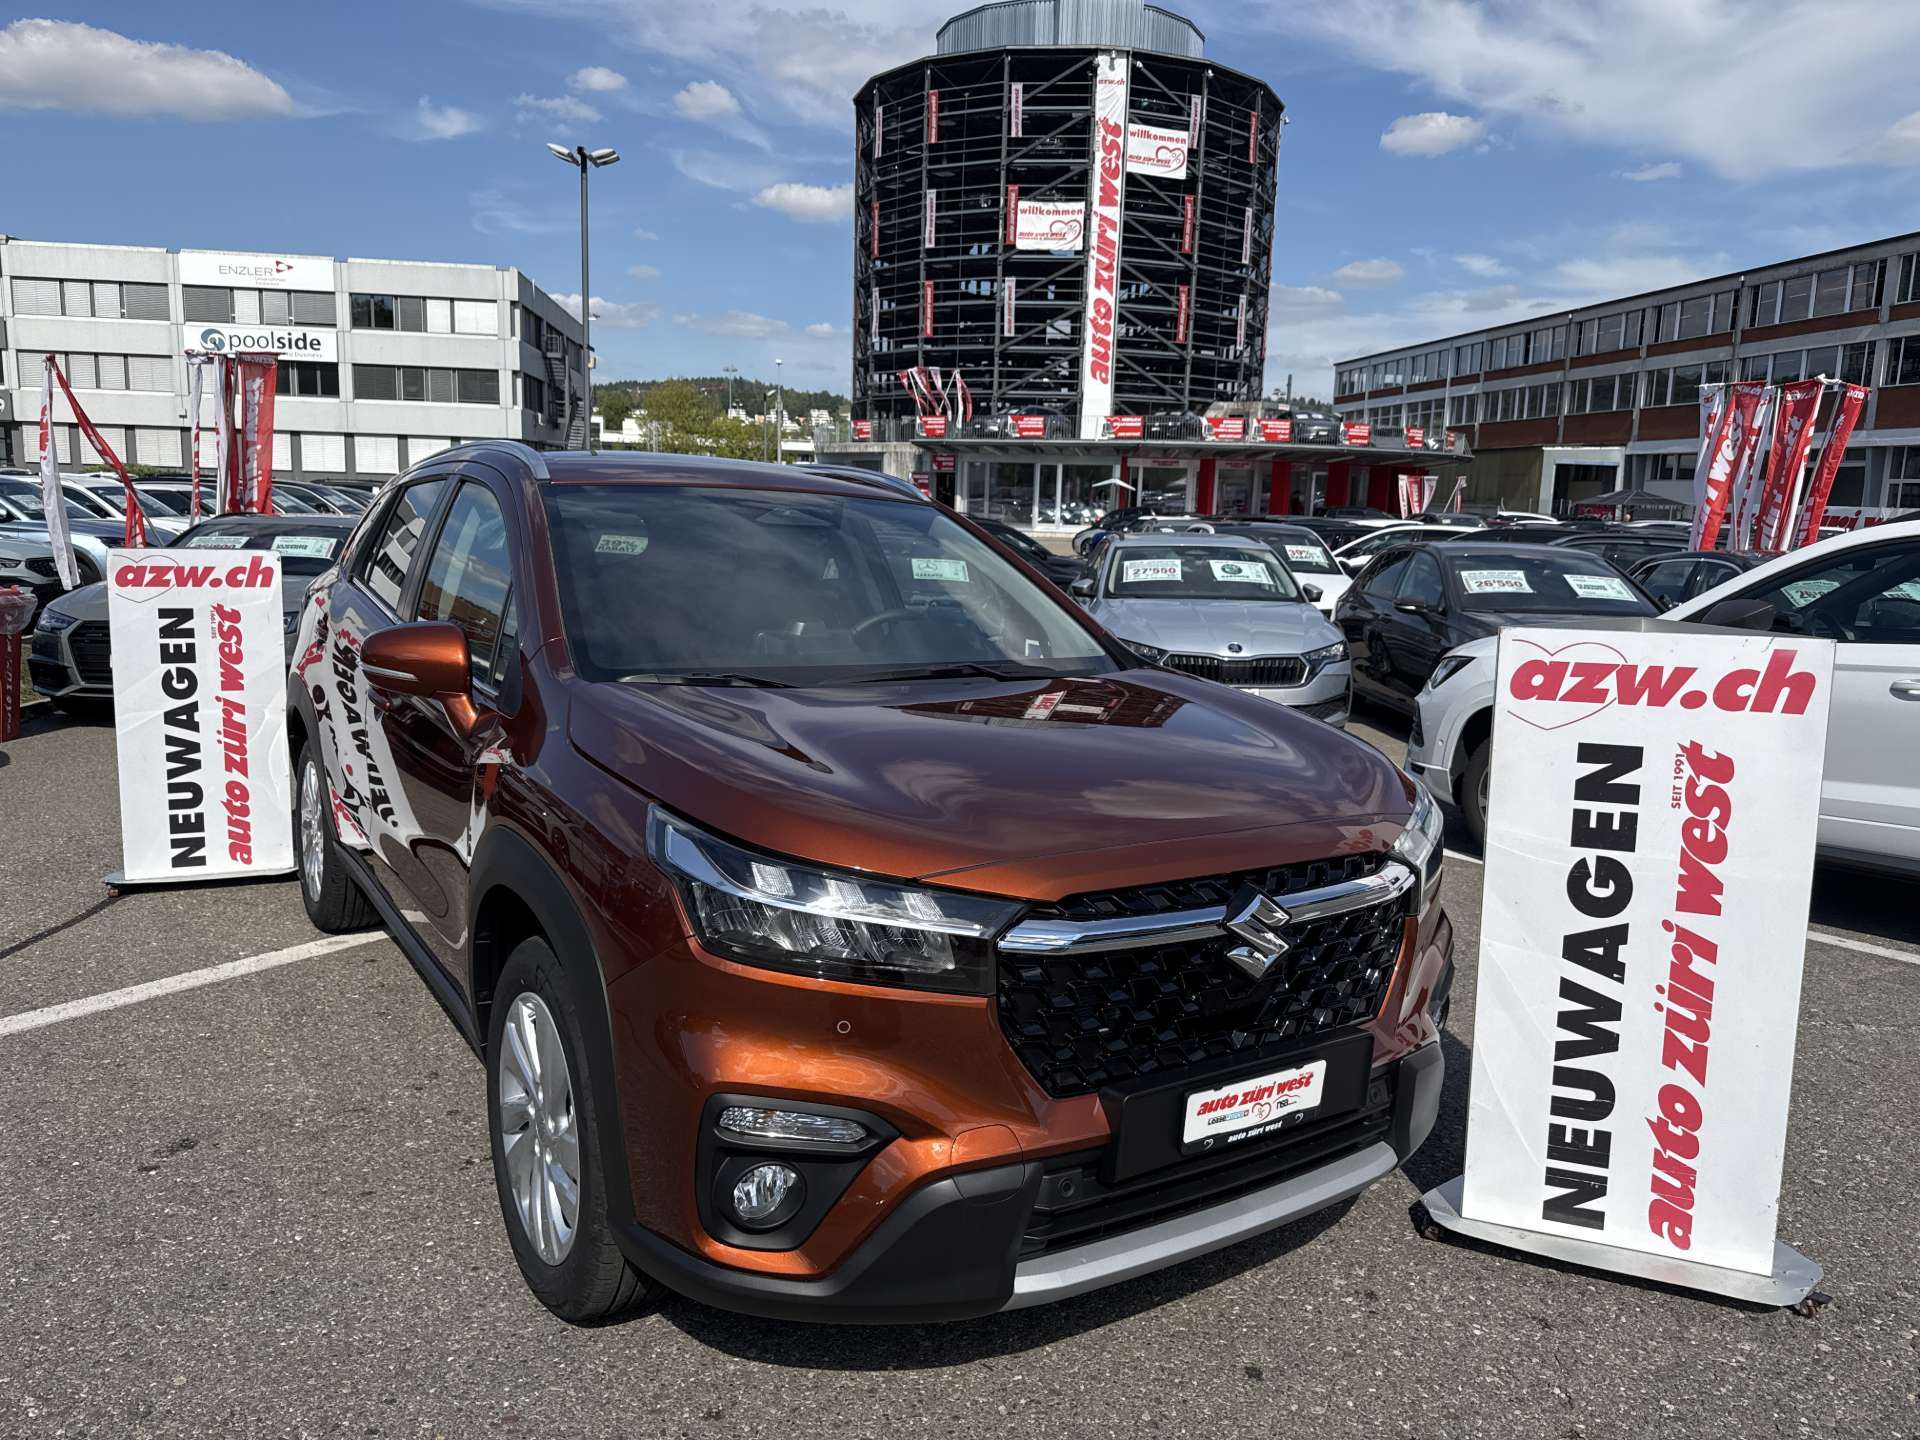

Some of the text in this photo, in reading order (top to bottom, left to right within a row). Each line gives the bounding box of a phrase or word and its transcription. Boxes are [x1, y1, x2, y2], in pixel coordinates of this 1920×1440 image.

[1129, 129, 1187, 144] willkommen
[1019, 205, 1083, 216] willkommen
[218, 265, 274, 277] ENZLER
[1089, 116, 1122, 385] auto züri west
[229, 331, 322, 353] poolside
[115, 556, 274, 588] azw.ch
[1509, 649, 1816, 715] azw.ch
[158, 607, 207, 868] NEUWAGEN
[211, 602, 253, 865] auto züri west
[1671, 753, 1685, 809] SEIT 1991
[1542, 742, 1644, 1230] NEUWAGEN
[1645, 739, 1735, 1250] auto züri west
[1197, 1072, 1314, 1116] auto züri west
[1228, 1120, 1283, 1143] auto züri west
